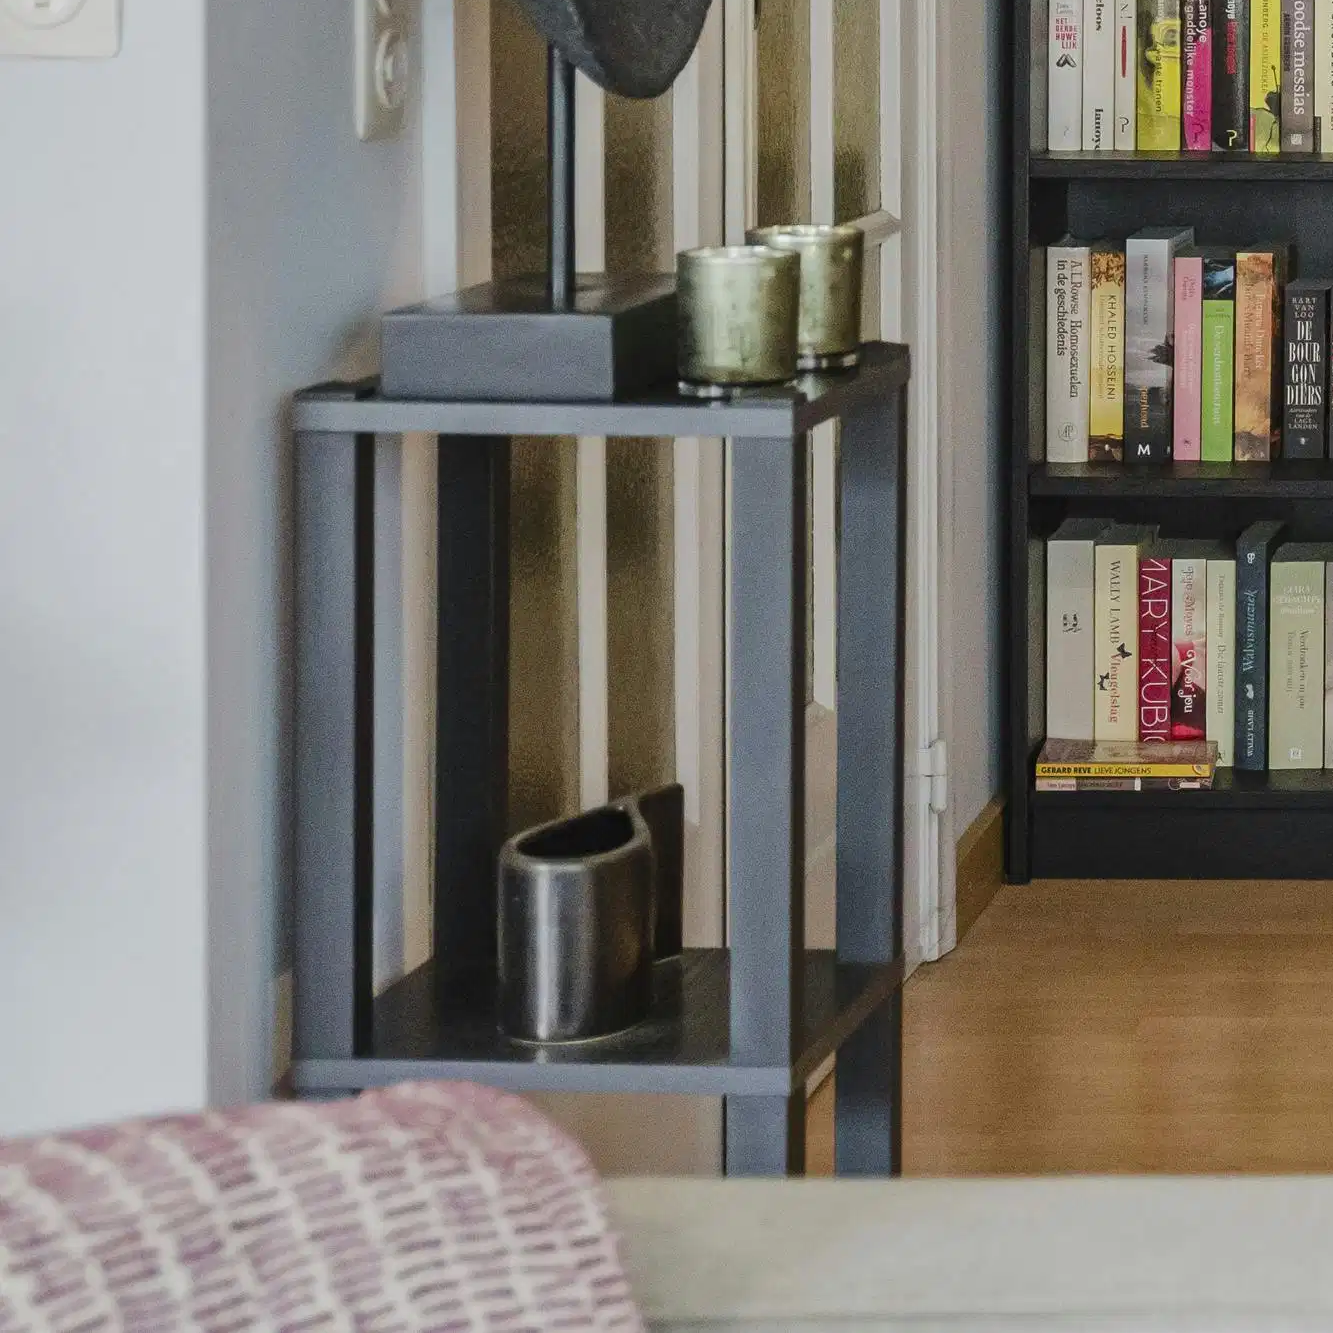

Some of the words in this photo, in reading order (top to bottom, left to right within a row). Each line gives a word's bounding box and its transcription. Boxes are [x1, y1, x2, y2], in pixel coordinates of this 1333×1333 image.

[1185, 6, 1195, 66] goddelijke
[1187, 70, 1195, 116] monster
[1295, 51, 1309, 115] messias
[1057, 260, 1067, 270] in
[1057, 273, 1067, 286] de
[1055, 288, 1068, 356] geschiedenis
[1107, 294, 1116, 340] KHALED
[1297, 321, 1313, 340] DE
[1070, 319, 1082, 398] Homosexuelen
[1107, 345, 1116, 400] HOSSEINI
[1288, 343, 1320, 362] BOUR
[1291, 364, 1316, 383] GON
[1110, 560, 1120, 602] WALLY
[1110, 608, 1120, 643] LAMB
[1108, 651, 1121, 722] Vleugelslag
[1180, 649, 1196, 690] Voor
[1178, 691, 1195, 713] jou
